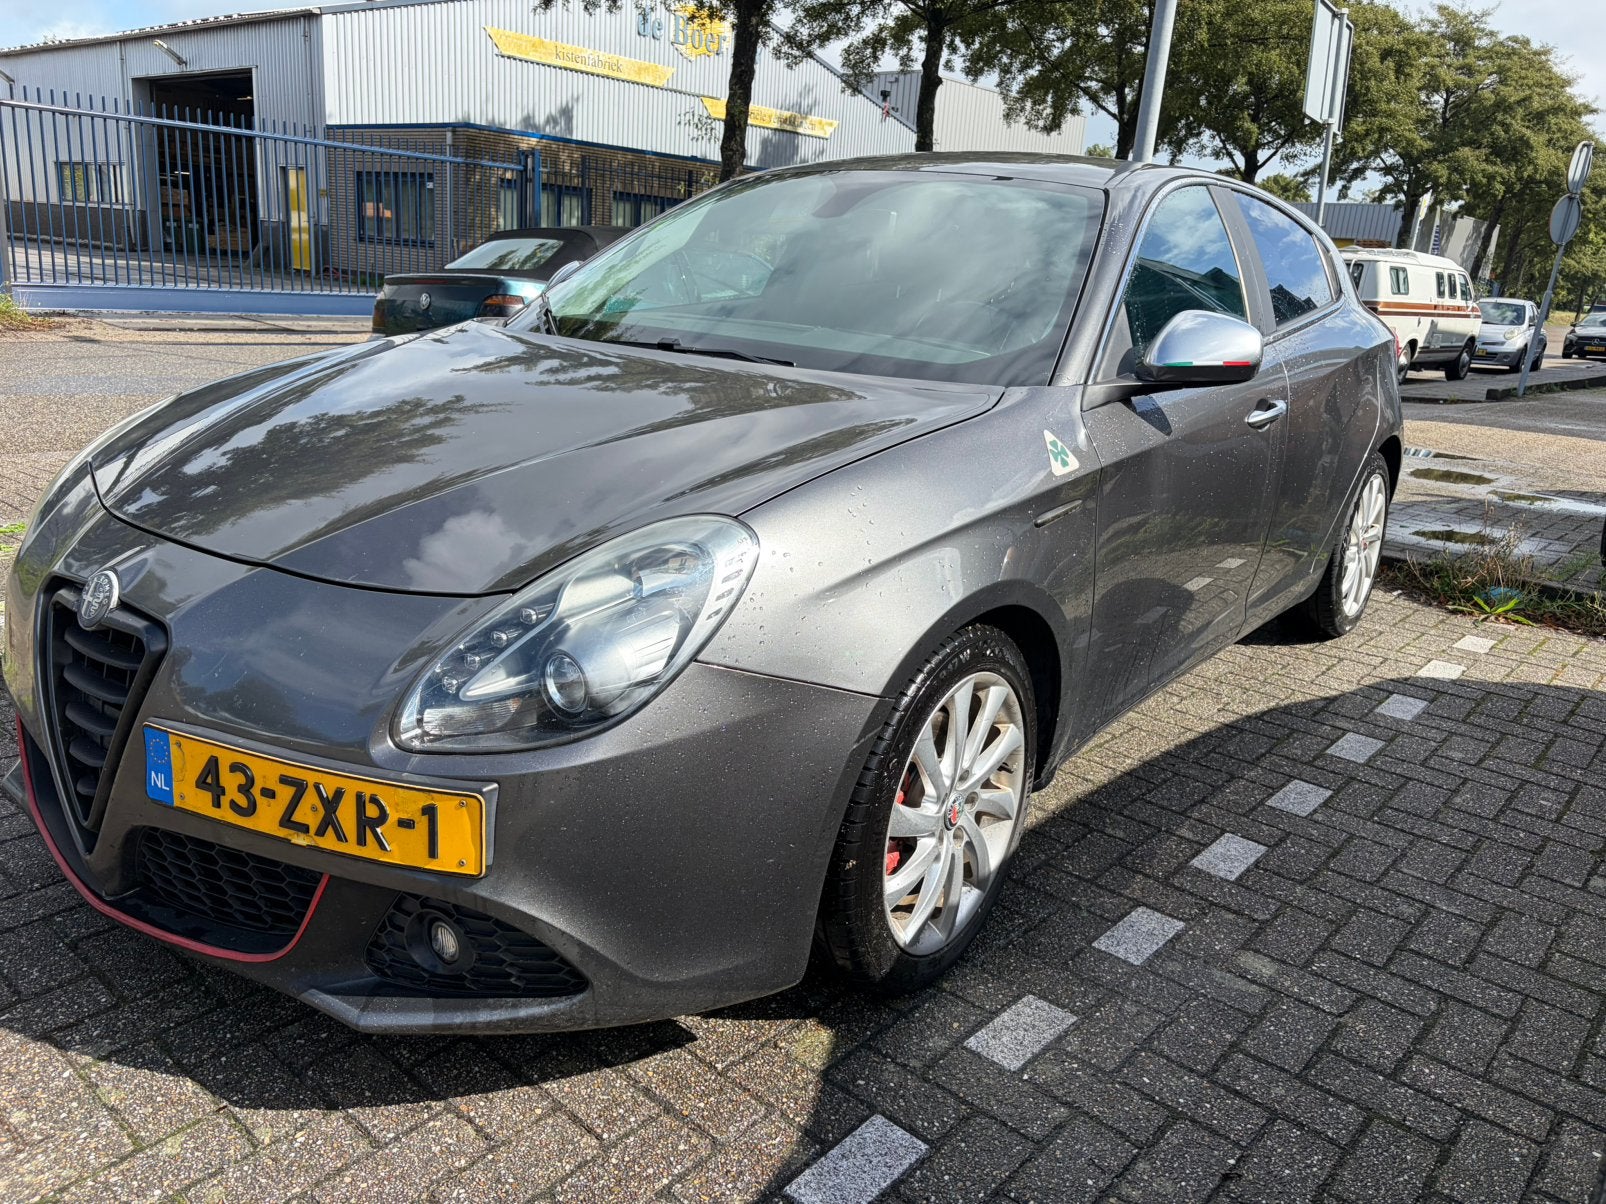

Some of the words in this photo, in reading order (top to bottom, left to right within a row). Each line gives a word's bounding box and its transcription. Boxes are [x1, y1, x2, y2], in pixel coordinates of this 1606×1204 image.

[638, 4, 664, 40] de
[671, 13, 728, 56] Boer
[554, 45, 623, 73] kistenfabriek
[150, 770, 170, 791] NL
[195, 755, 439, 860] 43-ZXR-1
